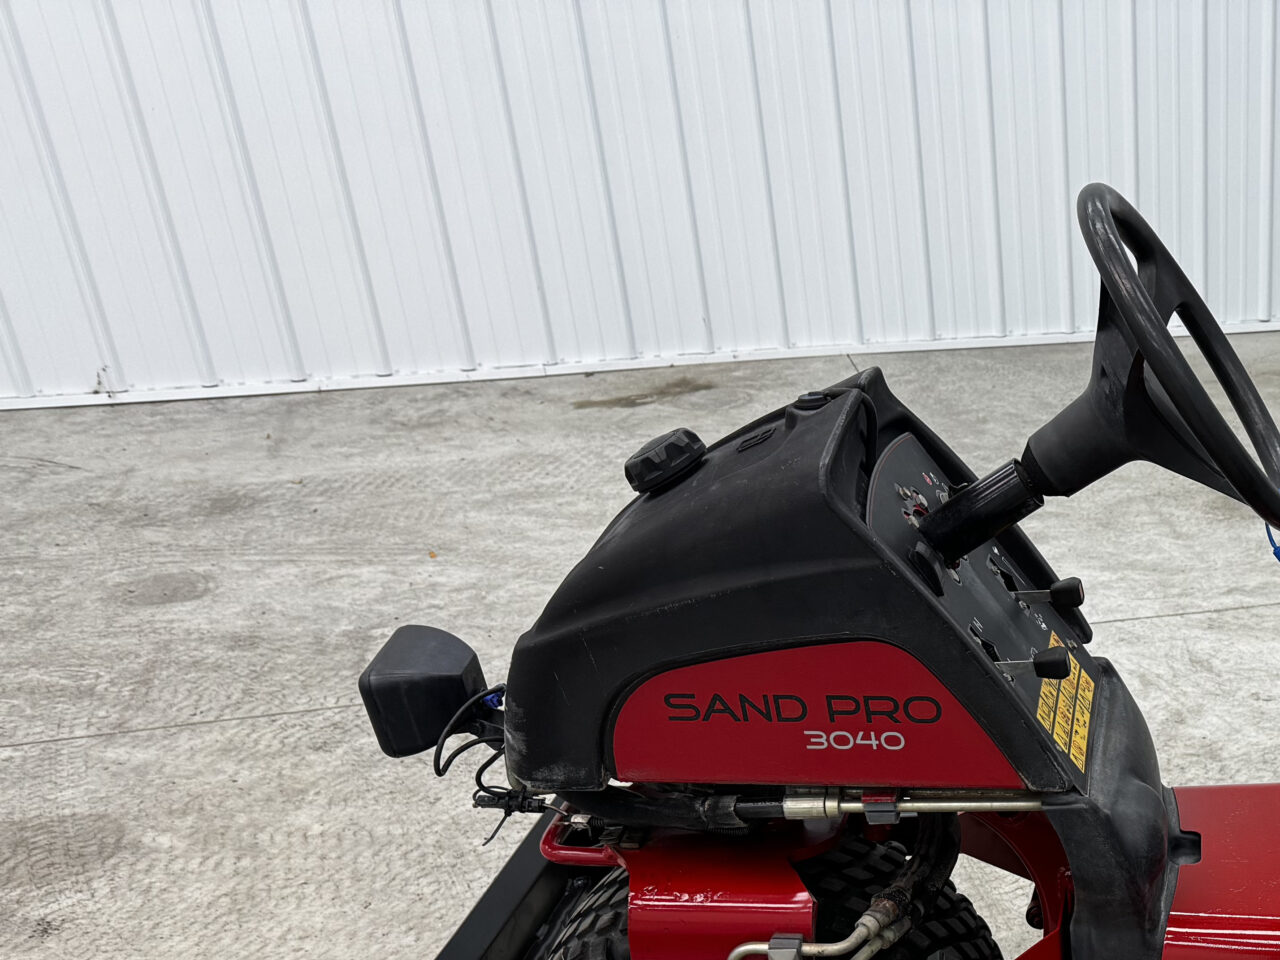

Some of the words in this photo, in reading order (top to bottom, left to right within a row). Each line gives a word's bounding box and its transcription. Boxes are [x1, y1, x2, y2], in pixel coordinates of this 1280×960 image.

[663, 693, 808, 723] SAND
[825, 694, 943, 724] PRO
[803, 730, 906, 751] 3040
